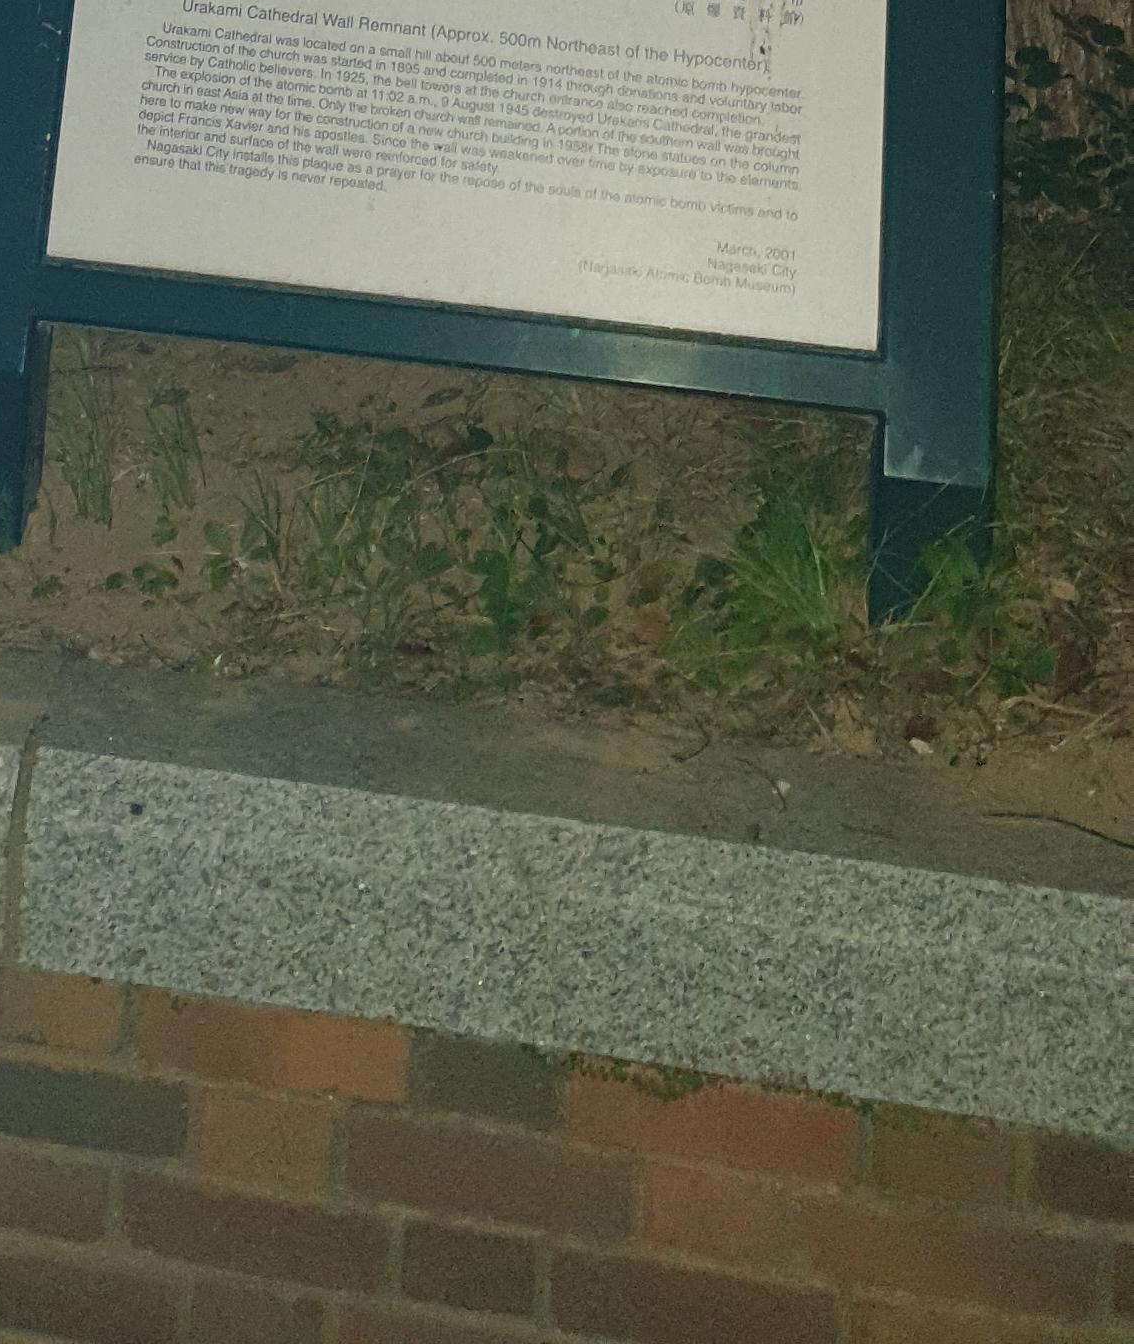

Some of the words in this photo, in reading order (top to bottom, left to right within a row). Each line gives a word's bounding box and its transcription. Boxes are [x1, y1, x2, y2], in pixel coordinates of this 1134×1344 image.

[161, 21, 212, 38] Urakami
[213, 27, 273, 44] Cathedral
[274, 35, 300, 47] was
[302, 36, 347, 52] located
[349, 43, 365, 54] on
[378, 46, 412, 59] small
[414, 47, 432, 61] hill
[435, 50, 470, 65] about
[472, 53, 497, 68] 500
[499, 58, 542, 72] meters
[545, 63, 604, 79] northeast
[246, 4, 318, 25] Cathedral
[321, 12, 354, 29] Wall
[358, 16, 426, 36] Remnant
[430, 23, 491, 43] (Approx.
[498, 30, 541, 48] 500m
[545, 35, 620, 56] Northeast
[624, 43, 640, 58] of
[644, 44, 668, 61] the
[143, 51, 187, 65] service
[188, 53, 204, 69] by
[207, 55, 256, 72] Catholic
[319, 67, 332, 80] In
[336, 69, 368, 85] 1925,
[372, 72, 392, 86] the
[394, 75, 418, 89] bell
[420, 78, 462, 94] towers
[464, 83, 477, 95] at
[479, 84, 500, 98] the
[502, 87, 546, 103] church
[548, 93, 604, 109] entrance
[144, 34, 221, 53] Construction
[222, 43, 235, 55] of
[237, 43, 257, 57] the
[258, 46, 300, 62] church
[302, 53, 328, 65] was
[330, 54, 373, 69] started
[375, 58, 386, 71] in
[391, 59, 420, 74] 1895
[423, 64, 447, 77] and
[449, 68, 514, 84] completed
[533, 74, 562, 89] 1914
[565, 78, 614, 97] through
[154, 64, 177, 78] The
[179, 69, 236, 84] explosion
[238, 74, 251, 86] of
[253, 74, 273, 88] the
[275, 78, 316, 93] atomic
[317, 81, 353, 97] bomb
[356, 86, 368, 98] at
[371, 87, 404, 102] 11:02
[452, 96, 495, 113] August
[499, 101, 529, 116] 1945
[137, 107, 175, 124] depict
[177, 111, 222, 128] Francis
[225, 116, 263, 132] Xavier
[266, 122, 290, 135] and
[292, 124, 310, 137] his
[372, 132, 407, 148] Since
[409, 137, 429, 151] the
[433, 141, 458, 154] wall
[489, 148, 554, 164] weakened
[556, 155, 585, 168] over
[139, 92, 167, 107] here
[169, 95, 181, 108] to
[183, 99, 217, 112] make
[219, 103, 245, 115] new
[247, 106, 272, 121] way
[274, 107, 291, 120] for
[293, 109, 313, 123] the
[315, 114, 389, 131] construction
[391, 120, 404, 133] of
[417, 125, 443, 137] new
[446, 126, 488, 142] church
[491, 130, 539, 150] building
[140, 78, 181, 93] church
[182, 82, 194, 95] in
[196, 85, 221, 98] east
[222, 86, 249, 101] Asia
[251, 90, 263, 102] at
[264, 91, 284, 104] the
[286, 93, 314, 108] time.
[317, 96, 346, 114] Only
[348, 100, 367, 113] the
[369, 102, 411, 118] broken
[413, 107, 455, 123] church
[457, 113, 481, 126] wall
[557, 124, 599, 139] portion
[133, 154, 175, 168] ensure
[177, 156, 202, 171] that
[203, 159, 226, 173] this
[228, 162, 274, 182] tragedy
[277, 167, 288, 181] is
[290, 172, 325, 185] never
[328, 176, 386, 192] repeated.
[136, 122, 156, 135] the
[158, 124, 200, 140] interior
[203, 131, 227, 143] and
[229, 134, 274, 149] surface
[276, 138, 290, 150] of
[291, 139, 312, 153] the
[314, 143, 339, 156] wall
[342, 147, 372, 160] were
[375, 149, 437, 167] reinforced
[145, 138, 203, 156] Nagasaki
[205, 145, 229, 162] City
[232, 148, 275, 164] installs
[277, 153, 299, 167] this
[301, 156, 344, 173] plaque
[346, 163, 362, 174] as
[375, 166, 416, 182] prayer
[419, 168, 435, 182] for
[438, 171, 459, 185] the
[462, 176, 505, 191] repose
[508, 179, 522, 192] of
[523, 180, 545, 195] the
